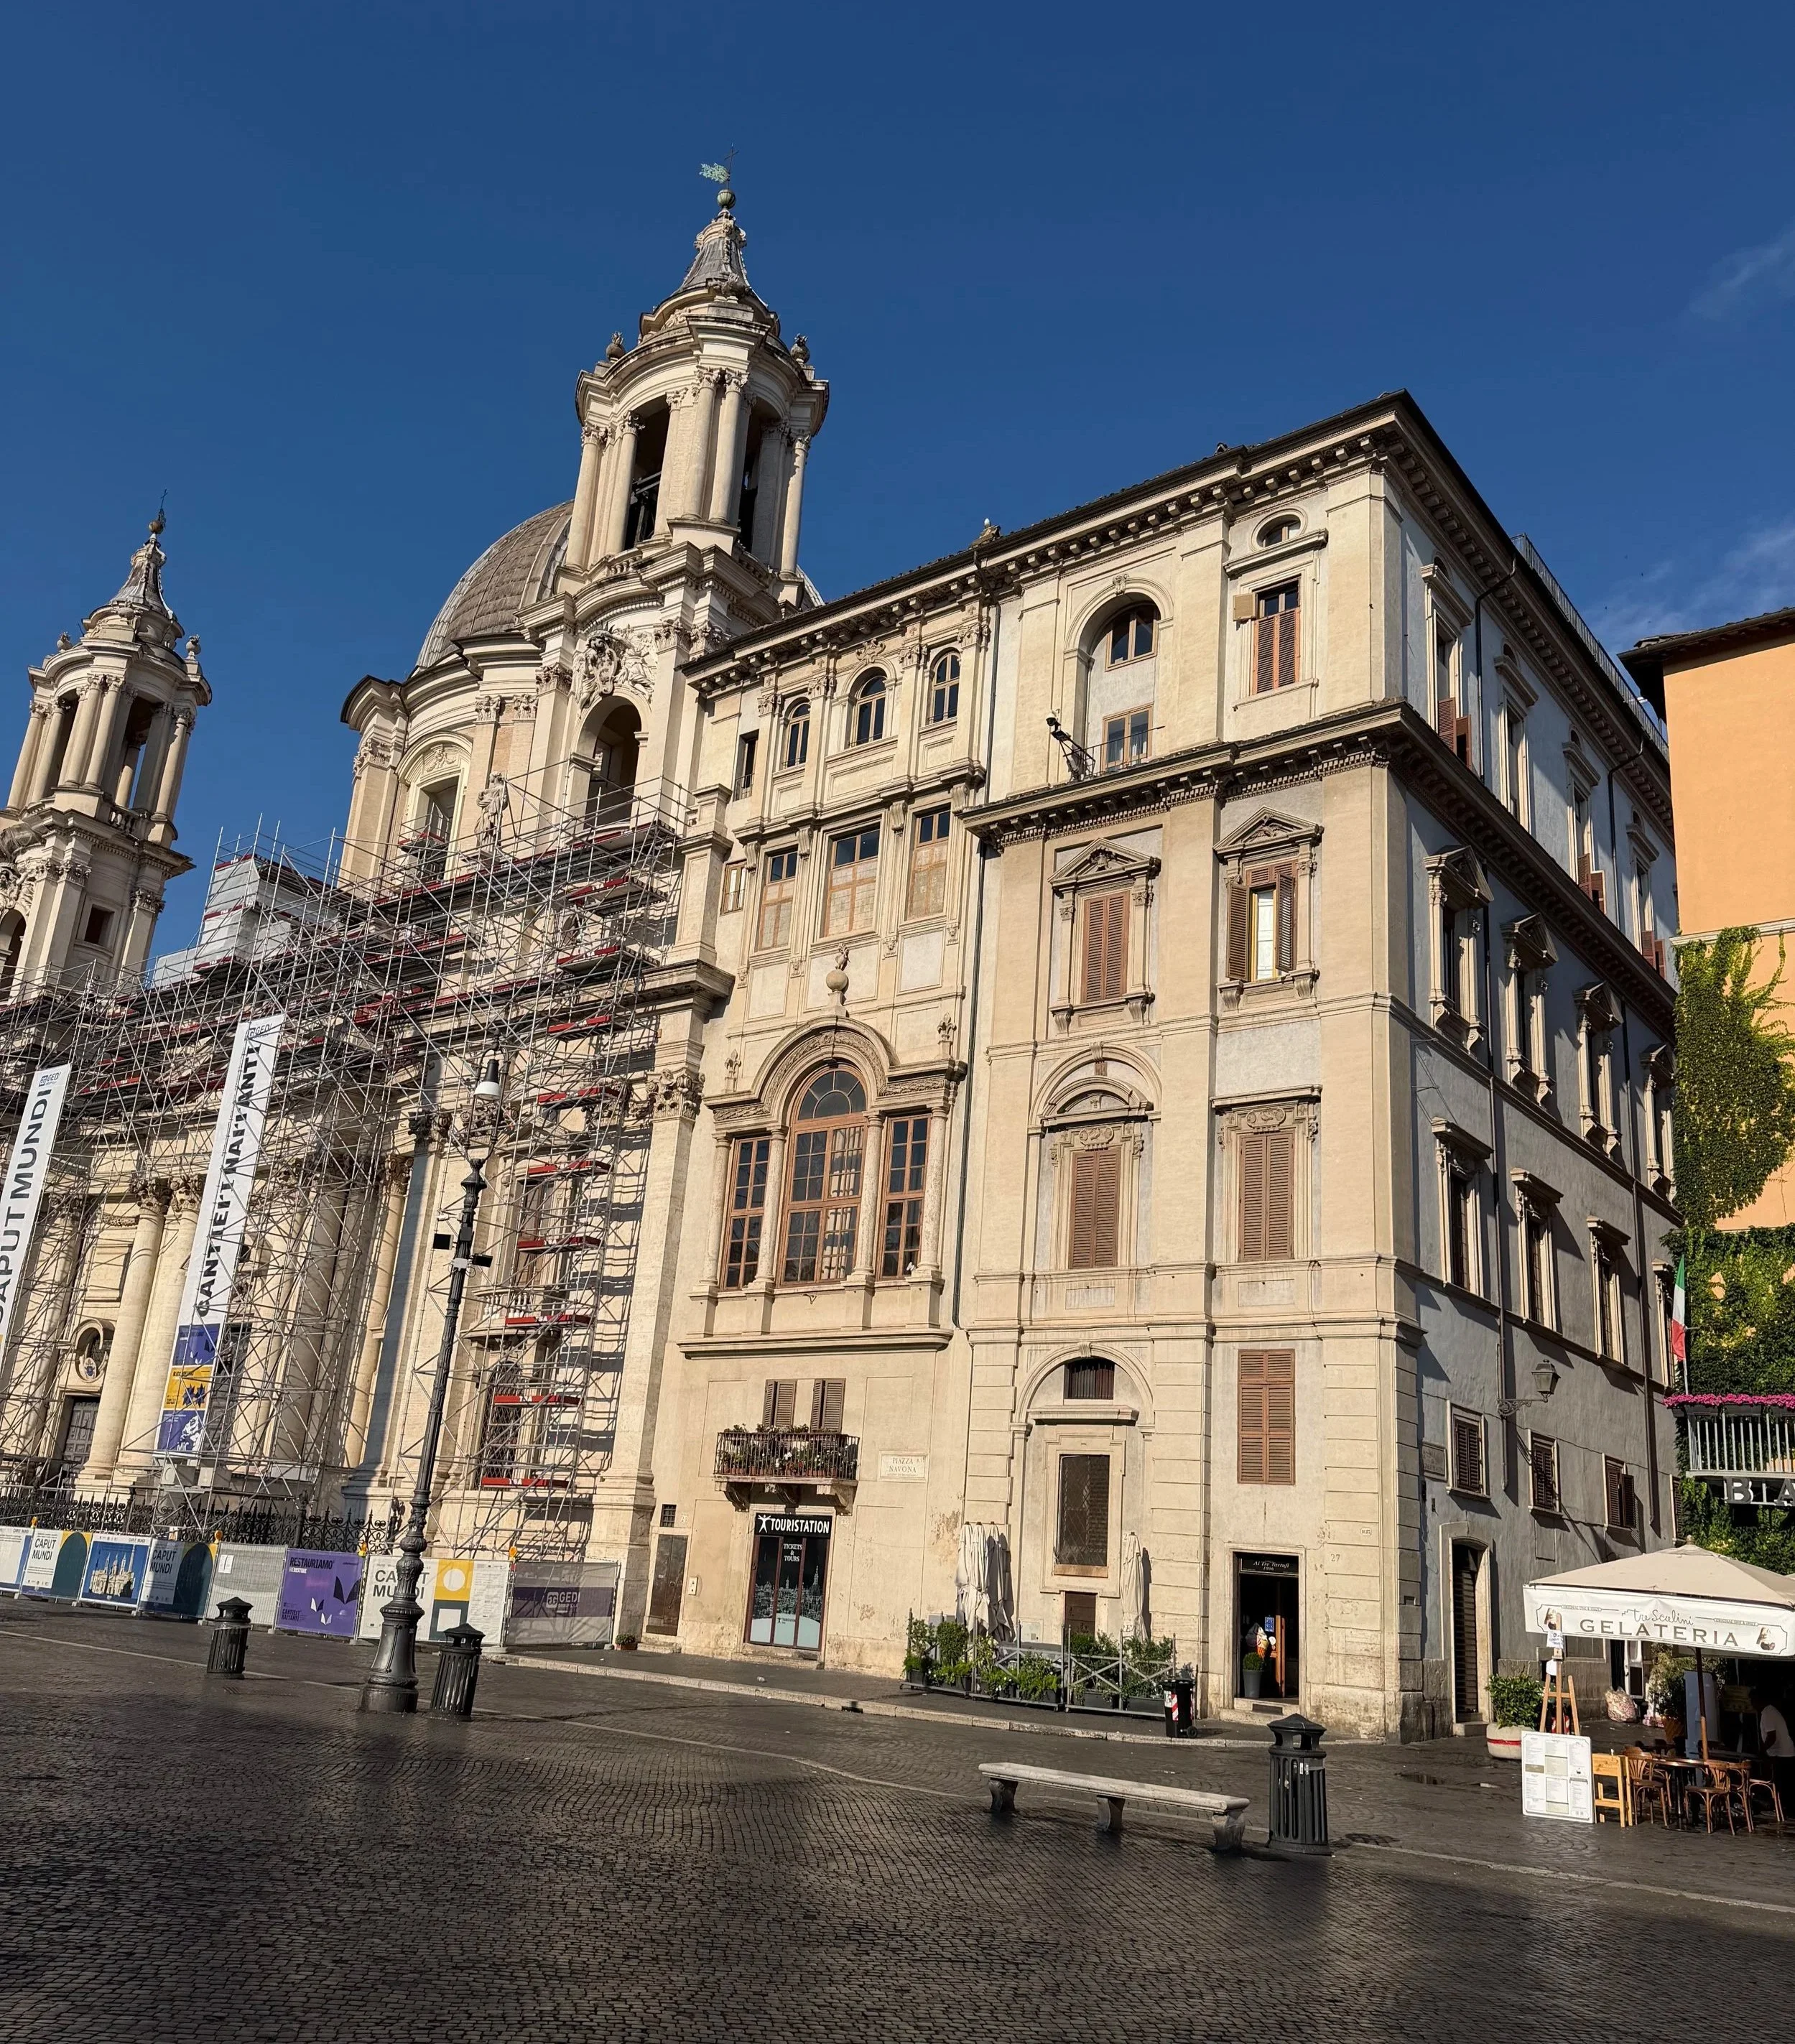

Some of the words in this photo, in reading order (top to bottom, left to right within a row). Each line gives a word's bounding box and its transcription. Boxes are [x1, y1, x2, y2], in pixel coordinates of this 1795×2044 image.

[10, 1089, 52, 1199] MUNDI
[0, 1206, 25, 1323] APUT
[771, 1518, 830, 1533] TOURISTATION
[34, 1538, 56, 1549] CAPUT
[32, 1550, 52, 1560] MUNDI
[152, 1549, 177, 1561] CAPUT
[1330, 1553, 1340, 1562] 27
[149, 1563, 172, 1574] MUNDI
[290, 1556, 333, 1569] RESTAURIAMO
[375, 1569, 430, 1584] CAT
[559, 1592, 580, 1603] GEDI
[1580, 1619, 1738, 1647] GELATERIA
